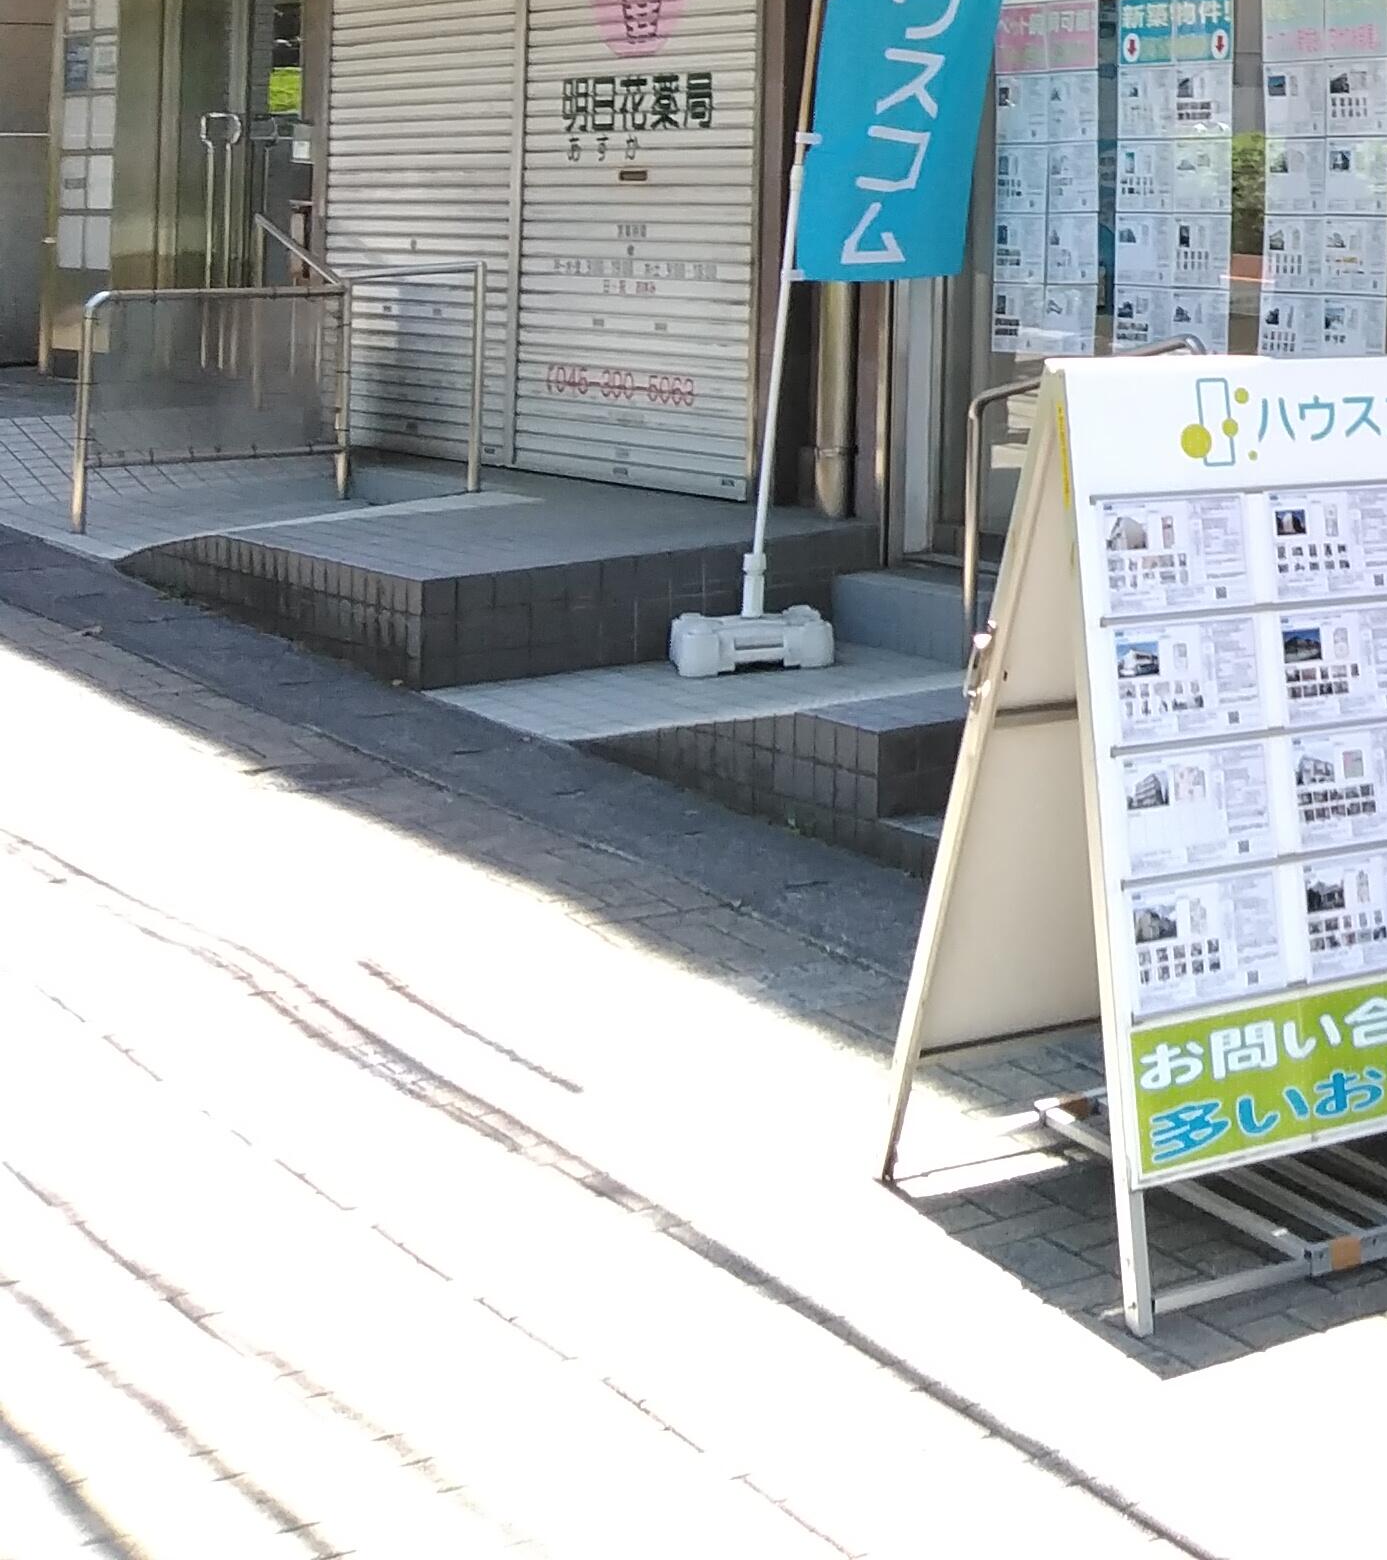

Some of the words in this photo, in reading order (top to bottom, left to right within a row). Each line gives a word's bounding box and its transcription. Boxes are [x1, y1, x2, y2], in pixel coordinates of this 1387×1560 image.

[562, 72, 713, 133] 明日花薬局
[567, 132, 639, 162] あすか
